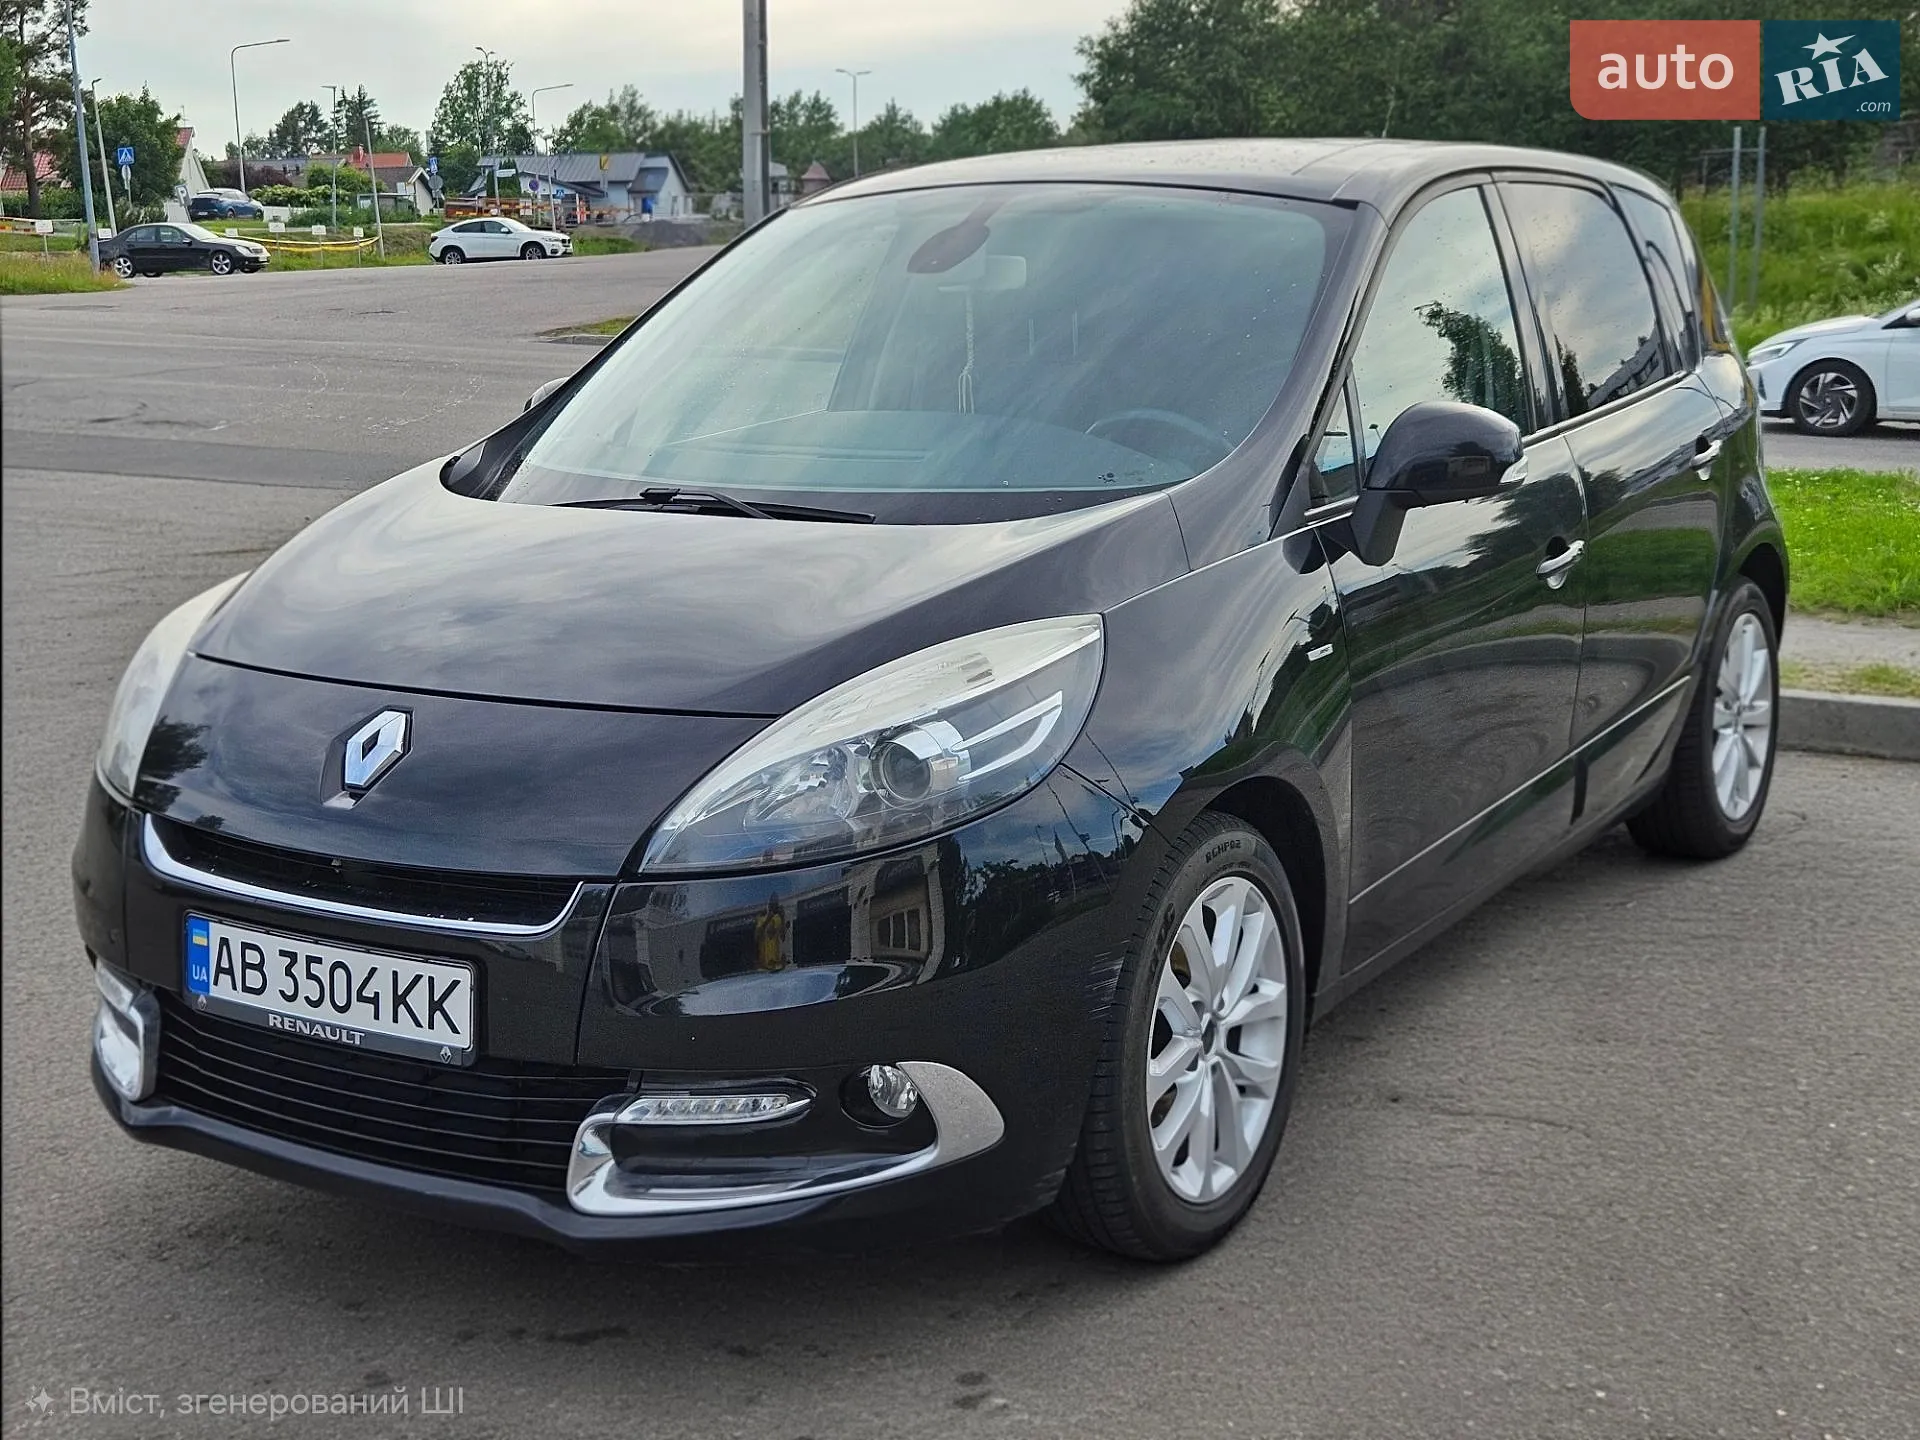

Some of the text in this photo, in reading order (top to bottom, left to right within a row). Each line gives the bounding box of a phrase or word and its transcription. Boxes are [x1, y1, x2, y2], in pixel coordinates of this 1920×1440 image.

[192, 963, 208, 983] UA
[212, 936, 268, 996] AB
[278, 949, 380, 1021] 3504
[268, 1013, 365, 1045] RENAULT
